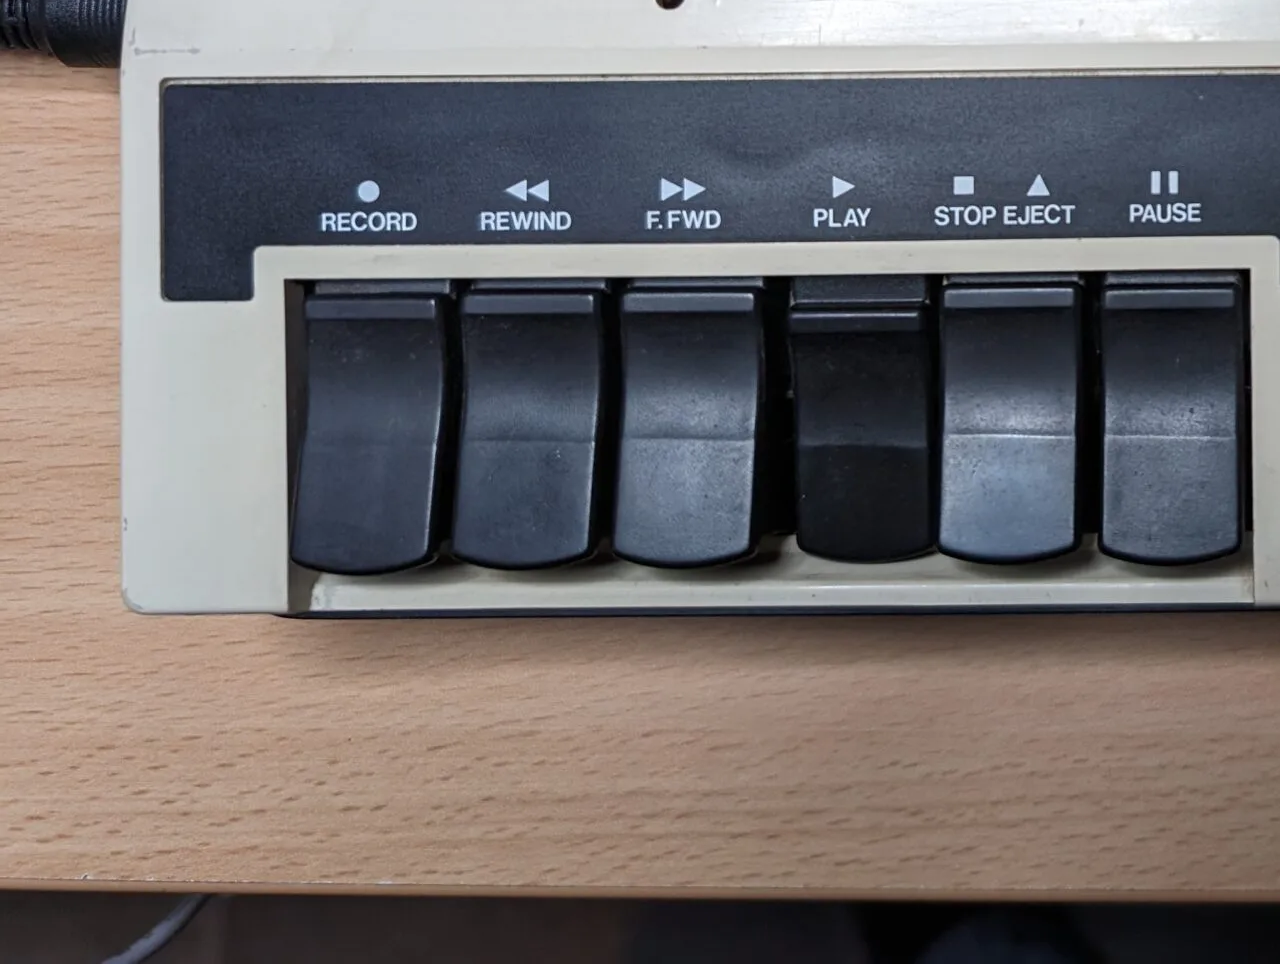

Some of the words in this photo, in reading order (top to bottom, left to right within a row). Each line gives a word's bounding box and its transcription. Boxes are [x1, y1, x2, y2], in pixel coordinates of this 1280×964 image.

[320, 211, 418, 233] RECORD
[480, 210, 572, 231] REWIND
[813, 207, 871, 228] PLAY
[934, 205, 997, 227] STOP
[1003, 204, 1076, 225] EJECT
[1129, 202, 1202, 223] PAUSE
